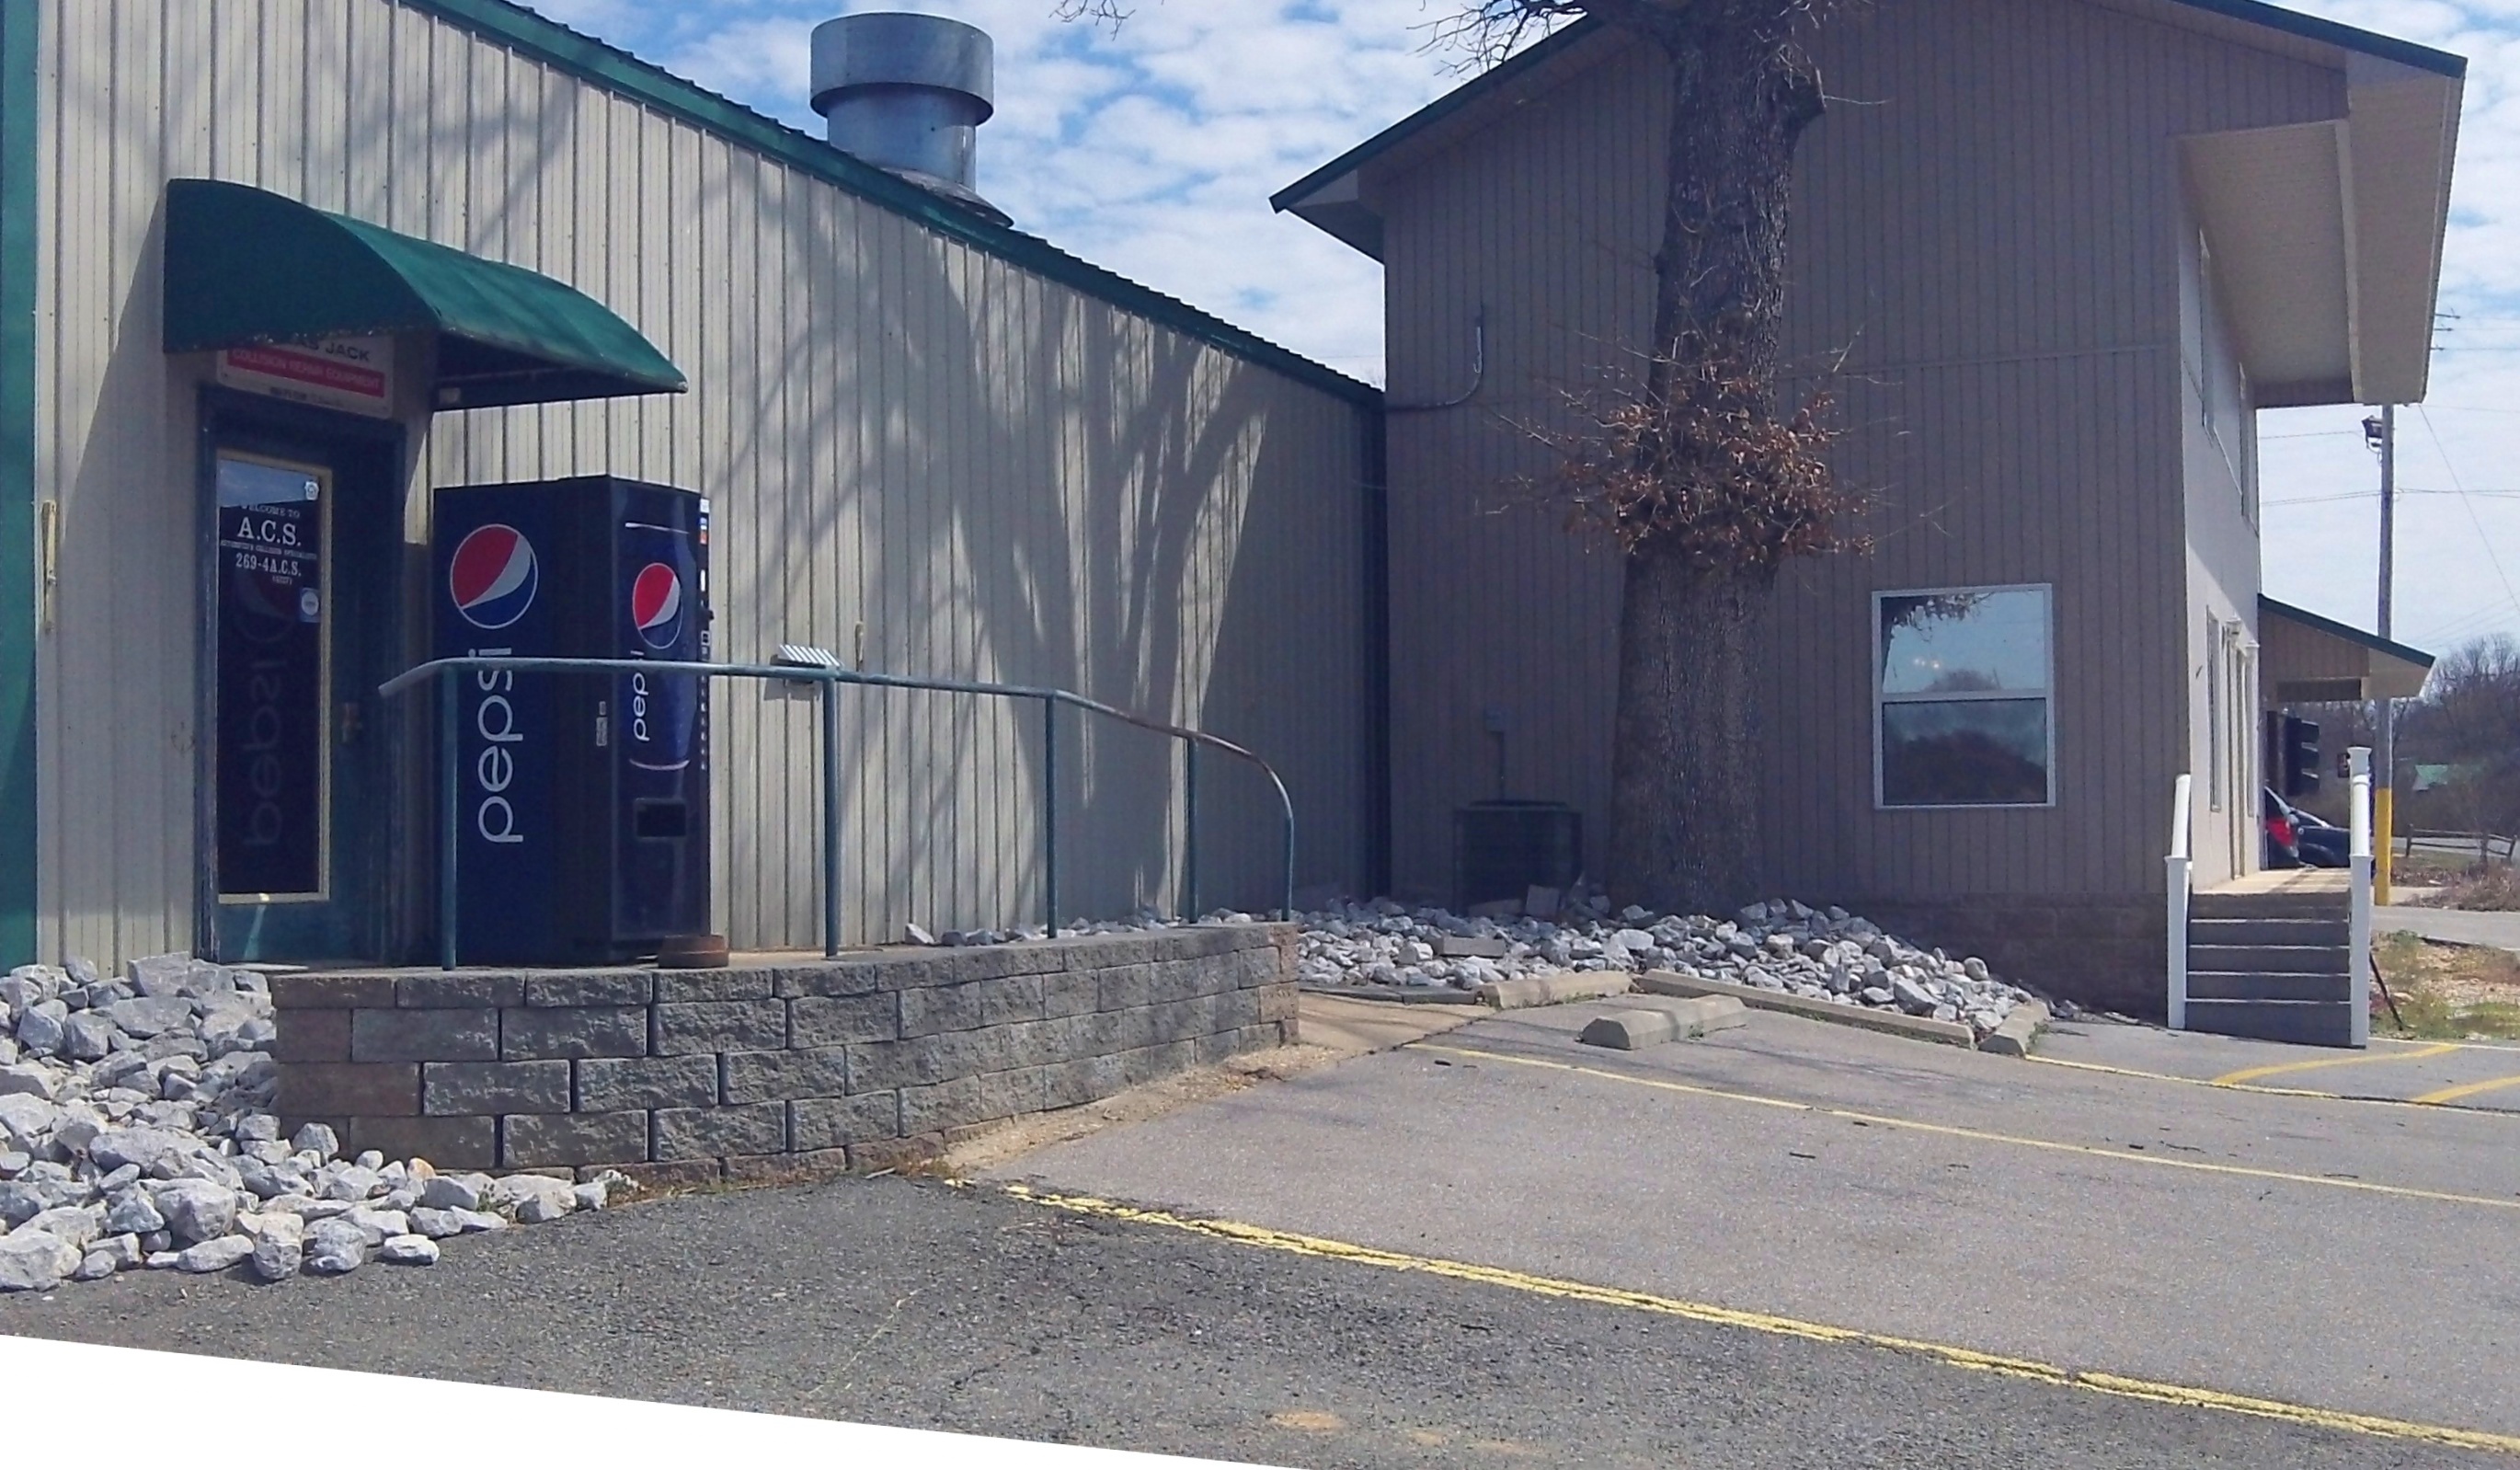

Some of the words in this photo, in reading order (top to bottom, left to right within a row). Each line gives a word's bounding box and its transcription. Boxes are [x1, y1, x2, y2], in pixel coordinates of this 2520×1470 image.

[326, 341, 370, 362] JACK
[237, 517, 302, 546] A.C.S.
[235, 552, 302, 577] 269-4A.C.S.
[630, 650, 650, 741] pepi
[468, 648, 523, 843] pepsi
